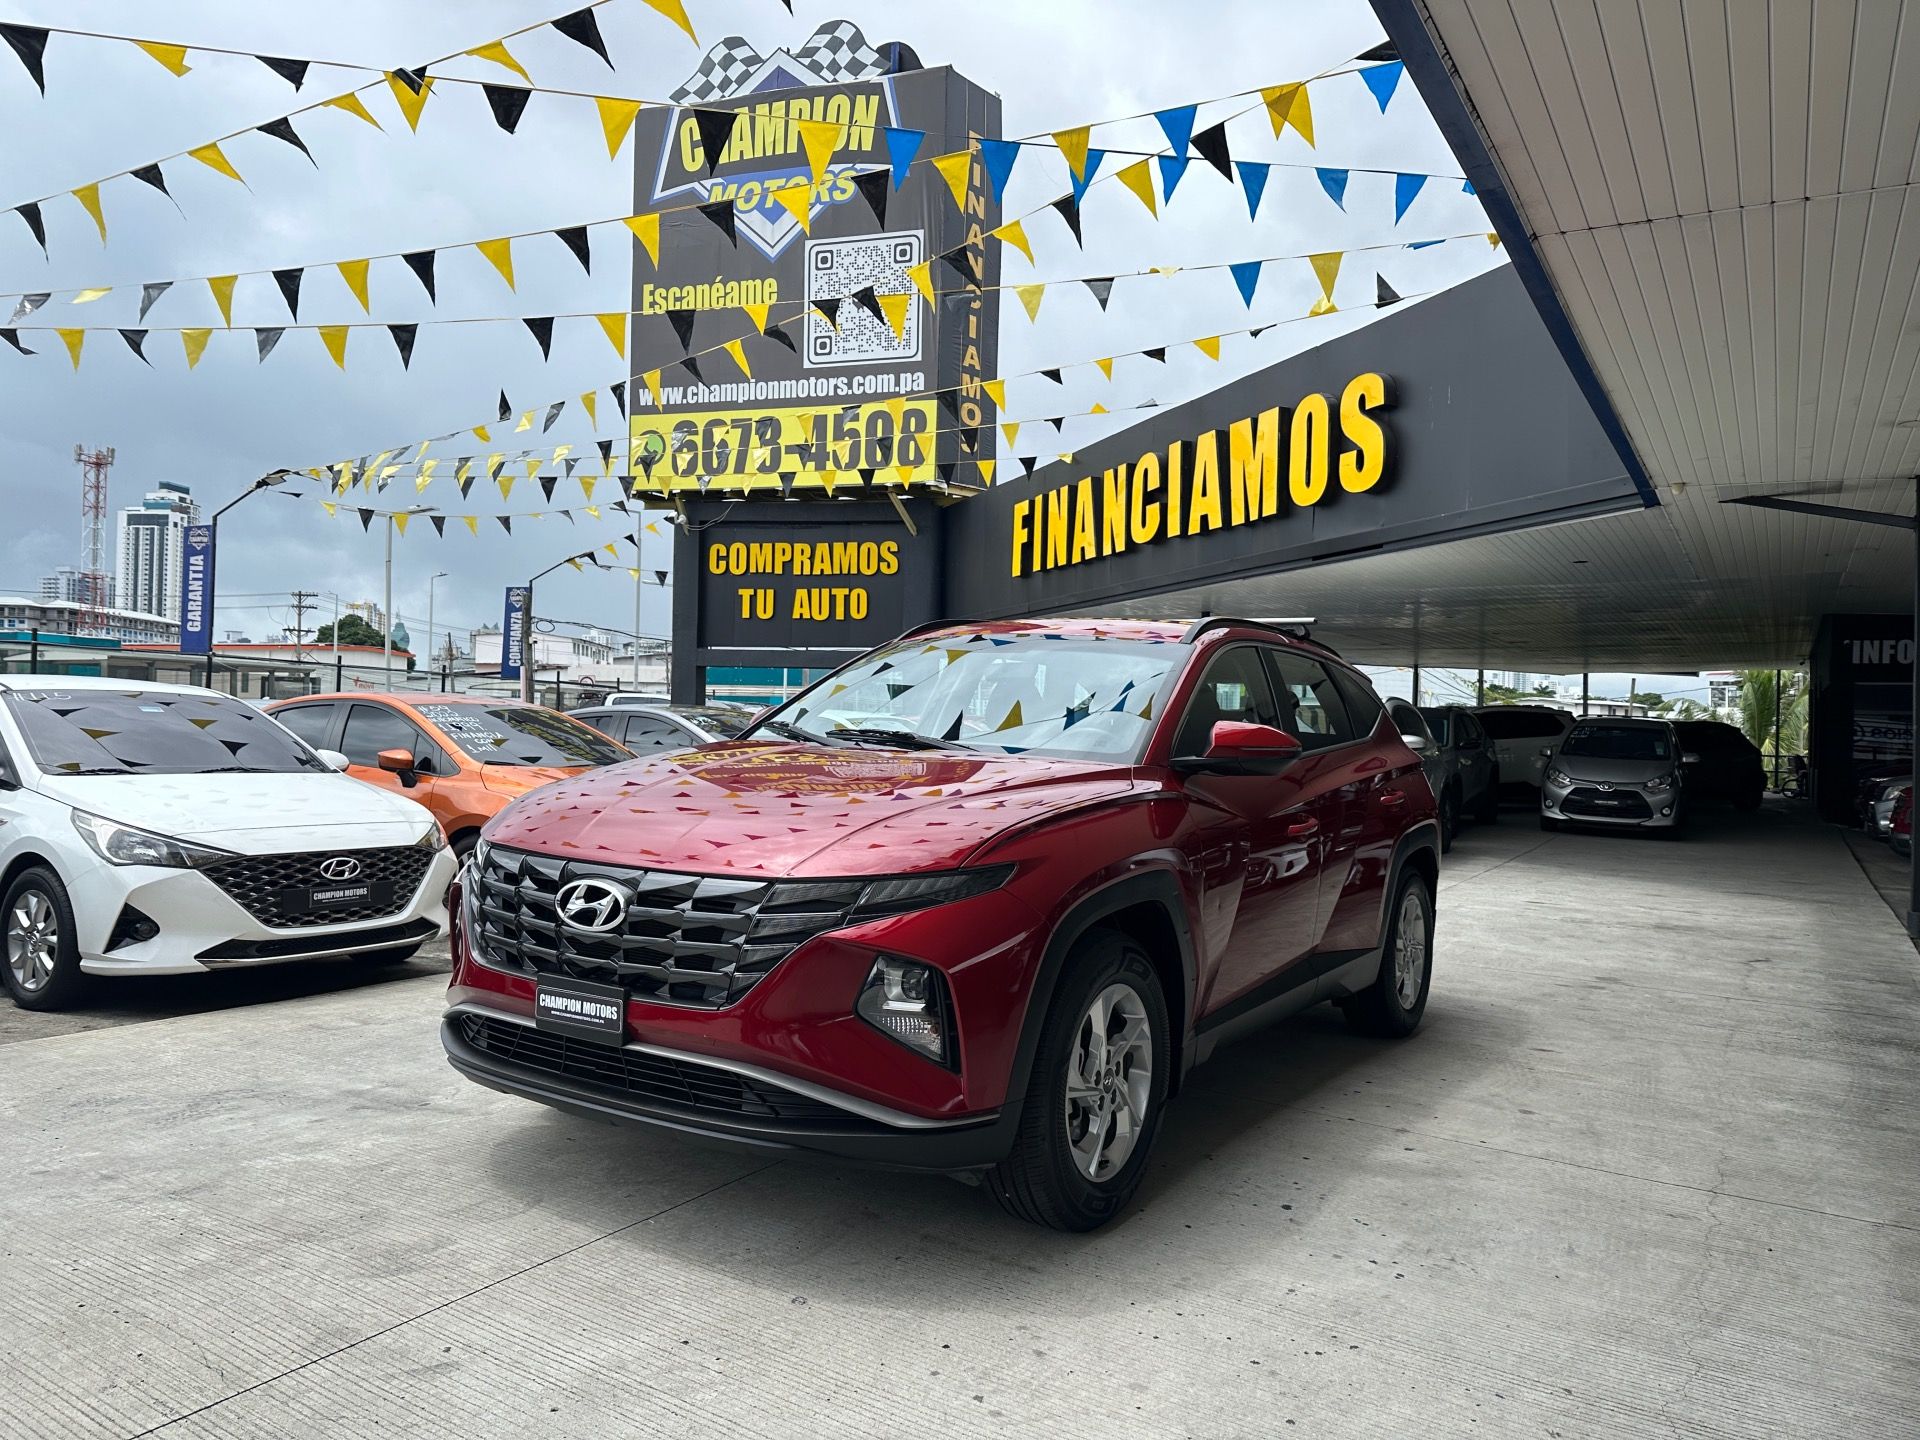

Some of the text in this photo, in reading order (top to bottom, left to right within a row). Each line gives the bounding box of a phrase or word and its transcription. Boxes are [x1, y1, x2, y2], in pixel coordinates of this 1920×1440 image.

[680, 94, 880, 172] CAMPON
[643, 276, 778, 315] Escanéame
[639, 371, 925, 406] www.championmotors.com.pa
[1012, 372, 1387, 577] FINANCIAMOS
[709, 541, 899, 575] COMPRAMOS
[187, 554, 204, 632] GARANTIA
[738, 588, 868, 621] TU AUTO
[508, 611, 522, 667] CONFIANZA
[313, 890, 344, 900] CHAMPION
[344, 887, 368, 897] MOTORS
[539, 993, 582, 1013] CHAMPION
[582, 1001, 618, 1020] MOTORS
